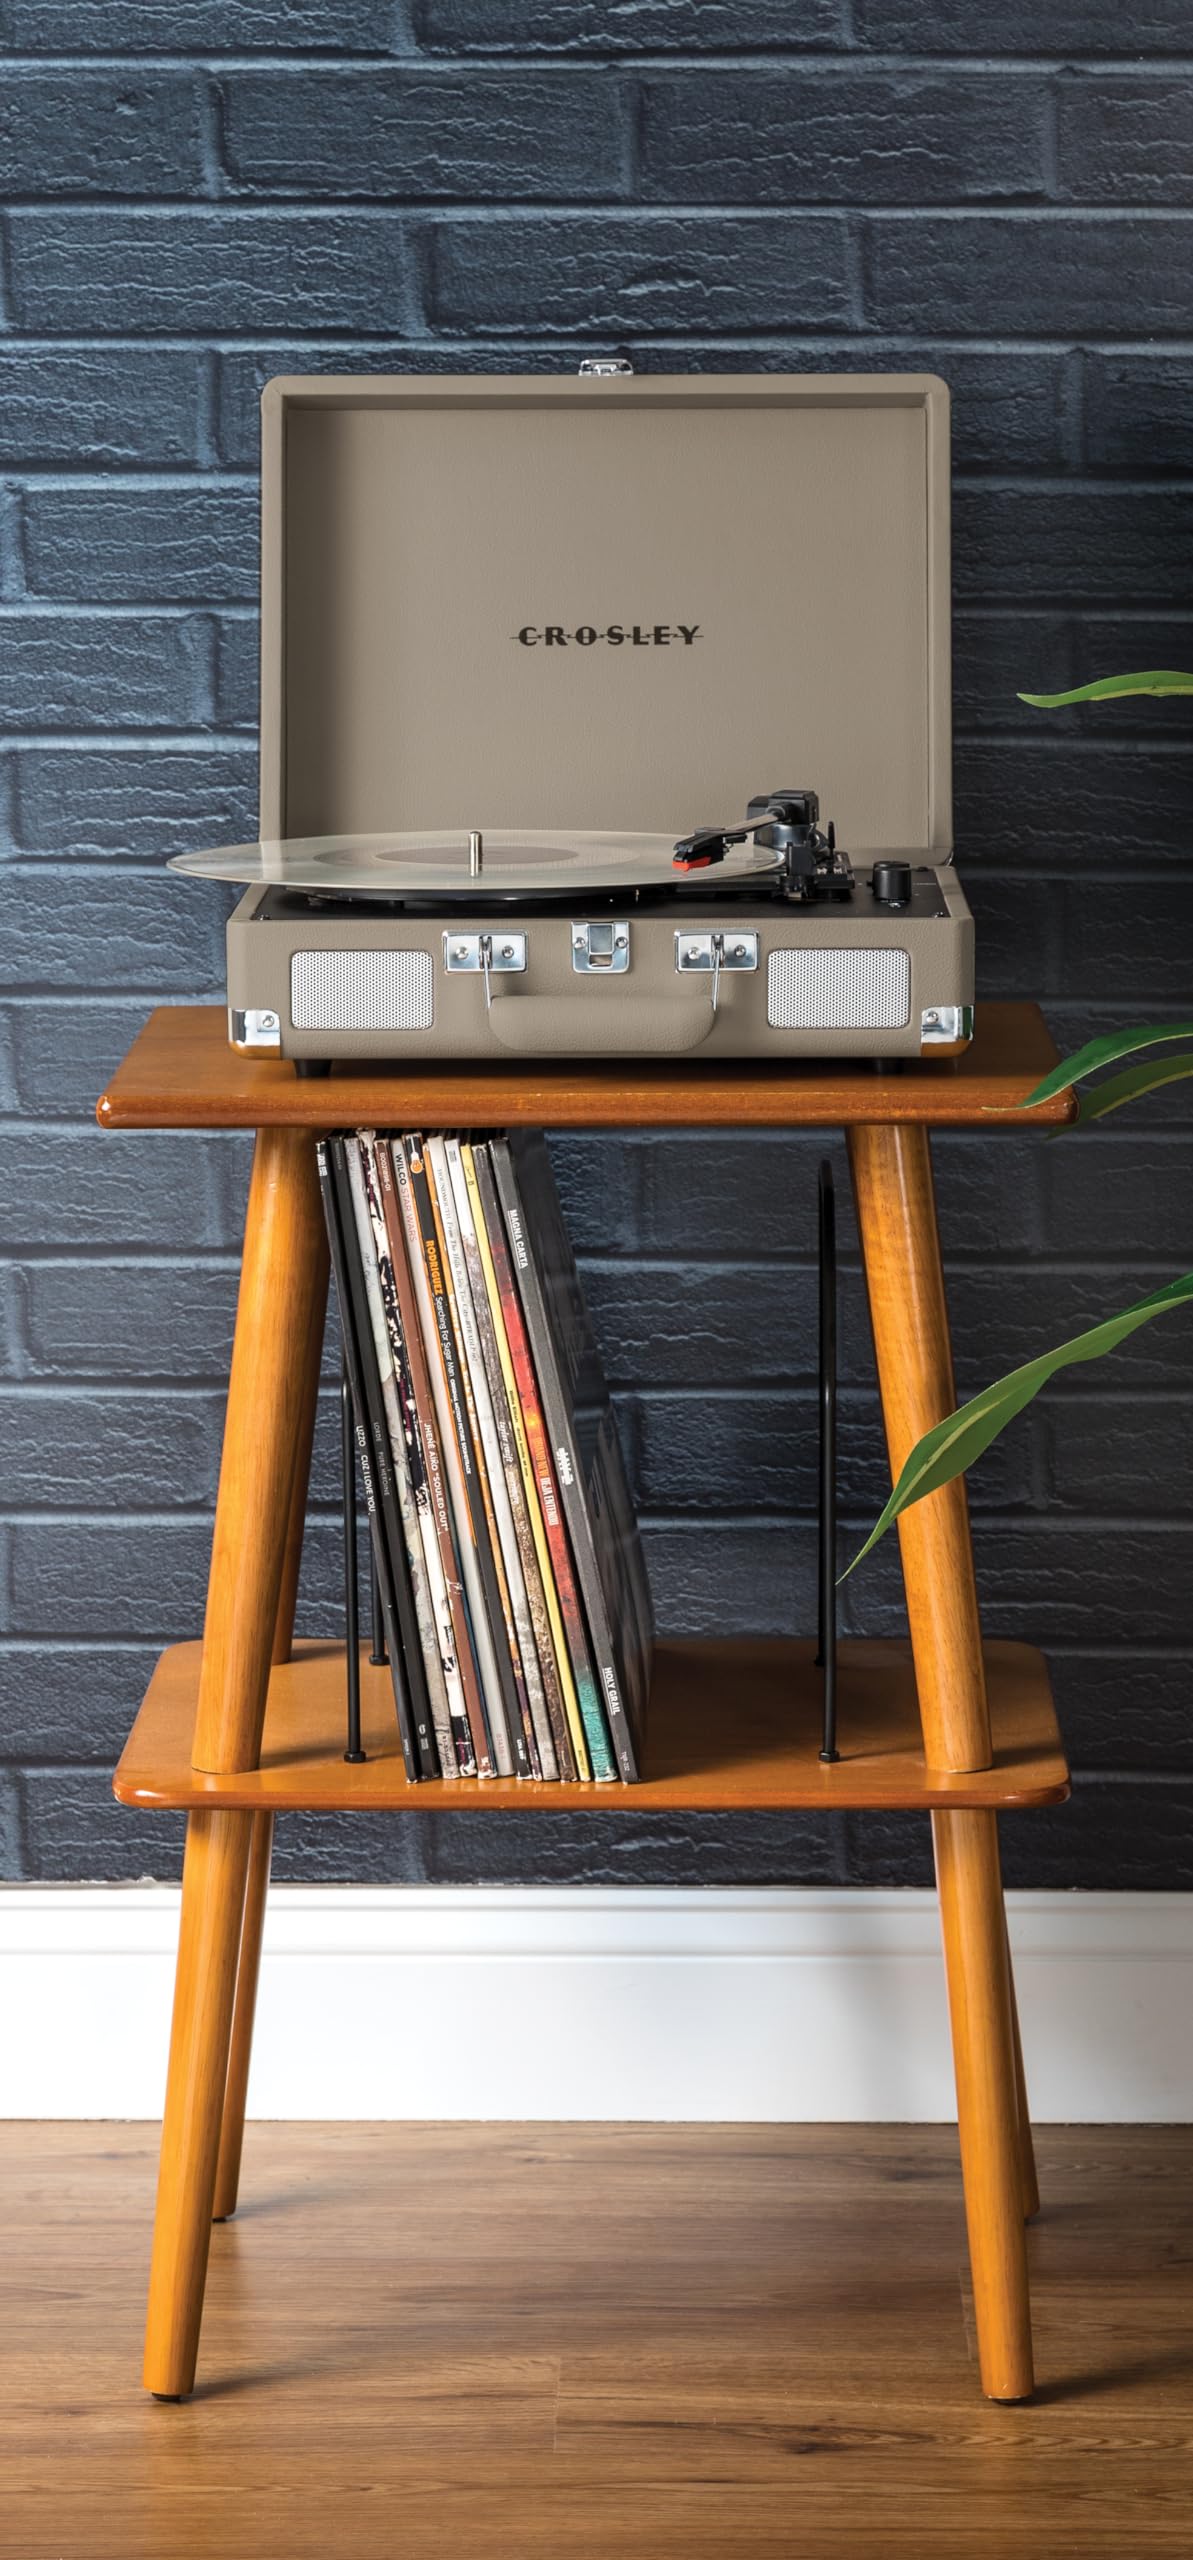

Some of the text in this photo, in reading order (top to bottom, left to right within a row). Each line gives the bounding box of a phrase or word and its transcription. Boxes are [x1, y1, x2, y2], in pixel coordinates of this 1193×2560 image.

[518, 625, 700, 646] CROSLEY
[394, 1153, 417, 1242] WILCO STAR WARS
[508, 1208, 528, 1268] MAGNA CARTA
[425, 1239, 443, 1295] RODRIGUEZ
[434, 1296, 447, 1329] Searching
[441, 1329, 449, 1341] For
[442, 1341, 453, 1361] Sugar
[446, 1361, 455, 1377] Man
[453, 1402, 461, 1422] MOTION
[355, 1425, 366, 1447] LIZZO
[457, 1422, 465, 1441] PICTURE
[360, 1454, 369, 1470] CUZ
[372, 1421, 389, 1496] LORDE PURE HEROINE
[363, 1475, 373, 1495] LOVE
[539, 1476, 553, 1495] DEJA
[431, 1472, 445, 1509] "SOULED
[438, 1510, 449, 1532] OUT"
[603, 1666, 620, 1715] HOLY GRAIL
